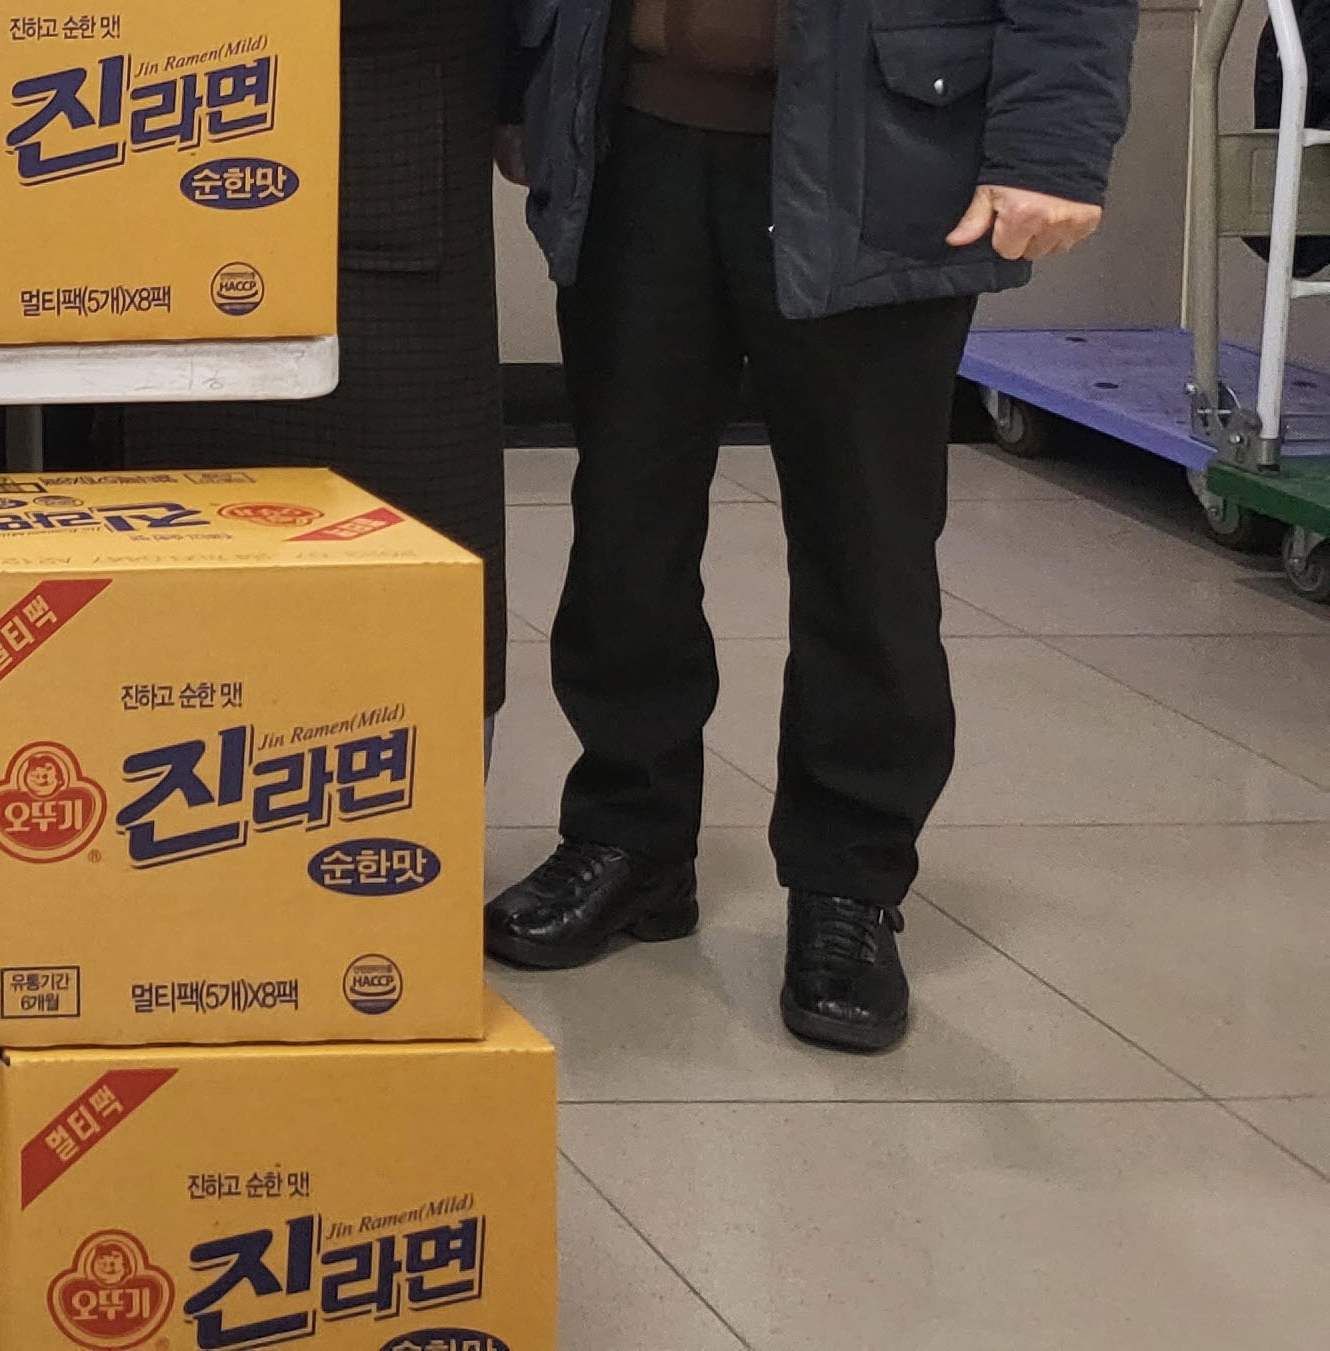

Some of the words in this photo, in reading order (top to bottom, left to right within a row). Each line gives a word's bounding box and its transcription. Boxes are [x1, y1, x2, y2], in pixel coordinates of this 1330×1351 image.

[10, 17, 58, 40] 진하고
[62, 16, 96, 39] 순한
[134, 62, 158, 78] Jin
[164, 35, 268, 70] Ramen(Mild)
[5, 53, 278, 186] 진라면
[191, 166, 287, 201] 순한맛
[219, 281, 257, 293] HACCP
[122, 684, 174, 710] 진하고
[179, 683, 216, 708] 순한
[258, 733, 284, 751] Jin
[291, 703, 405, 744] Ramen(Mild)
[115, 724, 417, 868] 진라면
[5, 801, 83, 832] 오뚜기
[321, 848, 428, 885] 순한맛
[10, 973, 70, 991] 유통기간
[353, 975, 394, 987] HACCP
[21, 992, 59, 1011] 6개월
[44, 1085, 125, 1163] 멀티팩
[188, 1173, 241, 1199] 진하고
[246, 1172, 283, 1198] 순한
[326, 1222, 352, 1240] Jin
[358, 1192, 475, 1235] Ramen(Mild)
[72, 1287, 150, 1321] 오뚜기
